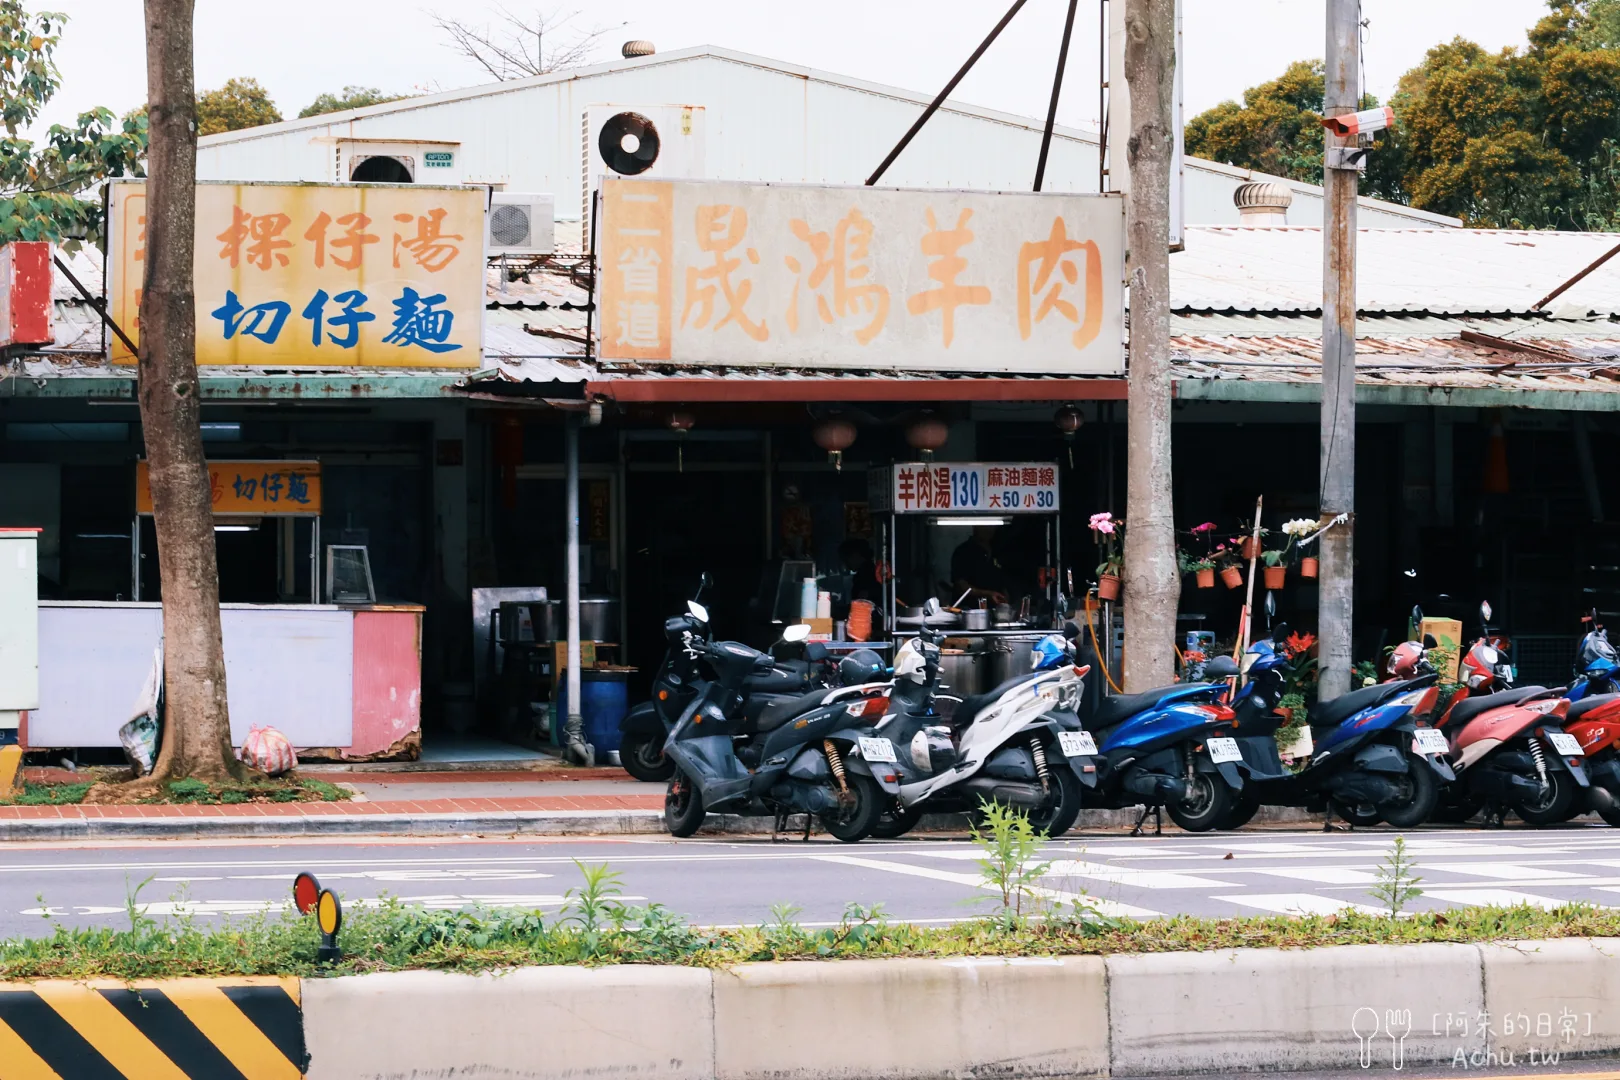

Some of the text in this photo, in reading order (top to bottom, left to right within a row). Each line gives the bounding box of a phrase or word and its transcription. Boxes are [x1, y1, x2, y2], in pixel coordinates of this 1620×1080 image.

[216, 204, 464, 273] 粿仔湯
[680, 204, 1103, 350] 晟鴻羊肉
[211, 288, 463, 354] 切仔麵
[232, 472, 311, 504] 切仔麵
[987, 467, 1055, 487] 麻油麵線
